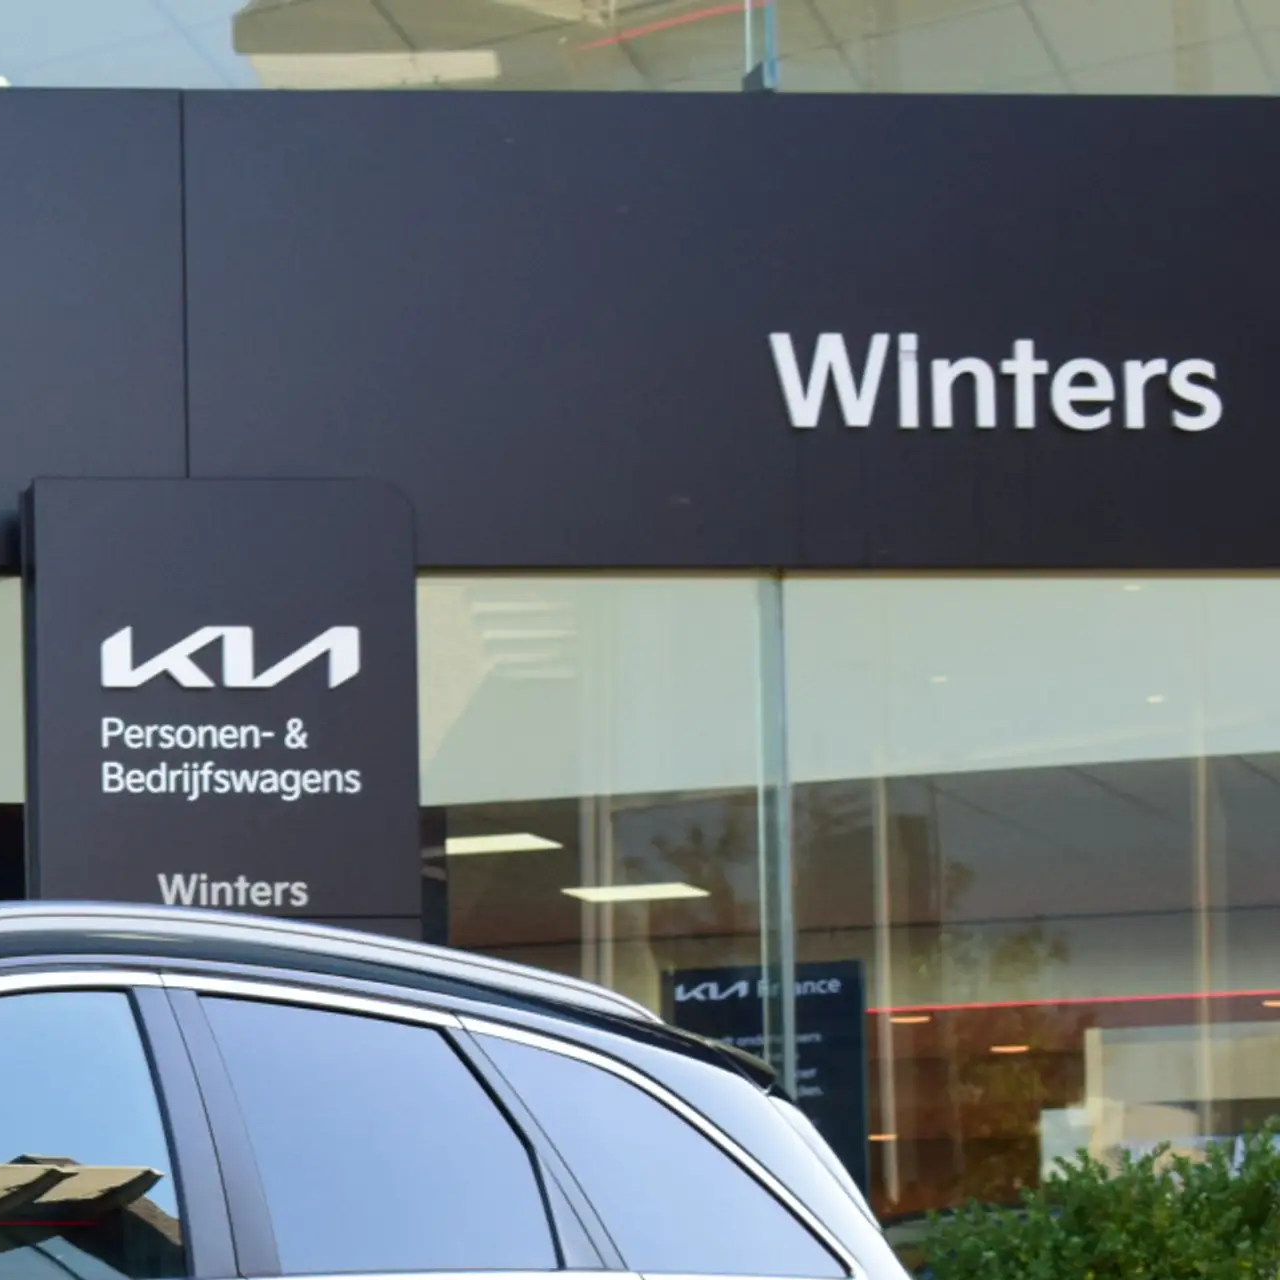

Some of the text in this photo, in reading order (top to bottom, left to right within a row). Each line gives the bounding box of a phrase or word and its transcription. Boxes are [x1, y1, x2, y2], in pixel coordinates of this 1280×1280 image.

[769, 332, 1223, 432] Winters
[100, 625, 361, 688] KIA
[101, 716, 308, 750] Personen- &
[101, 760, 362, 802] Bedrijfswagens
[157, 872, 309, 907] Winters
[674, 980, 750, 1002] KIA
